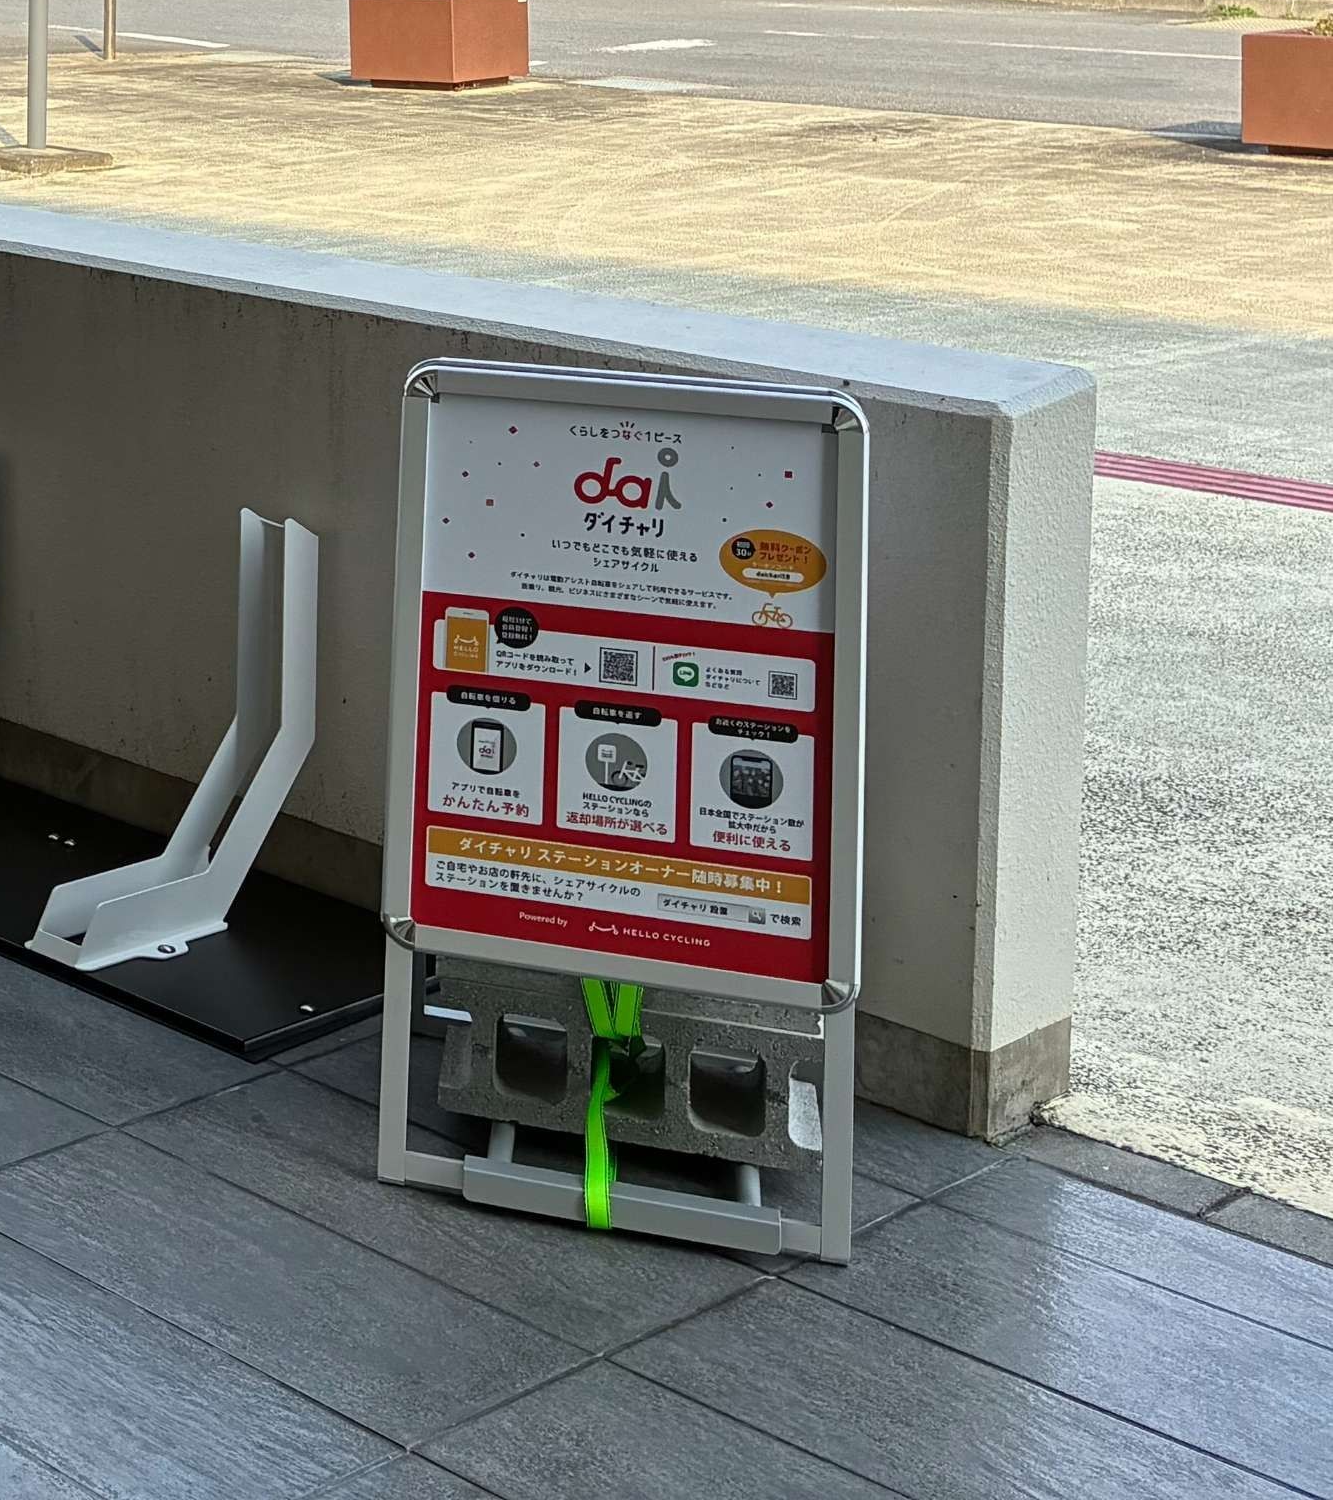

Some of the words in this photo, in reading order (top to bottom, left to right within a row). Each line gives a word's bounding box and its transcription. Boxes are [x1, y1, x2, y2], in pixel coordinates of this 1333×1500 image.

[569, 425, 682, 444] くらしをつなぐ1ピース
[573, 447, 682, 510] dai
[584, 512, 664, 538] ダイチャリ
[552, 539, 698, 562] いつでもどこでも気軽に使える
[759, 551, 808, 564] プレゼント！
[593, 557, 660, 573] シェアサイクル
[496, 650, 575, 666] QRコードを読み取って
[496, 660, 578, 676] アプリをダウンロード！
[592, 706, 643, 719] 自転車を返す
[715, 718, 791, 733] お近くのステーションを
[737, 728, 771, 739] チェック！
[452, 781, 521, 799] アプリで自転車を
[442, 794, 530, 818] かんたん予約
[582, 792, 609, 803] HELLO
[610, 795, 653, 809] CYCLINGの
[582, 801, 650, 818] ステーションなら
[565, 810, 668, 836] 返却場所が選べる
[699, 807, 805, 829] 日本全国でステーション数が
[713, 830, 791, 852] 便利に使える
[459, 836, 532, 859] ダイチャリ
[537, 848, 782, 894] ステーションオーナー随時募集中！
[435, 871, 584, 901] ステーションを置きませんか？
[436, 860, 641, 898] ご自宅やお店の軒先に、シェアサイクルの
[519, 911, 555, 925] Powered
[556, 916, 568, 928] by
[662, 898, 708, 912] ダイチャリ
[770, 913, 802, 926] で検索
[622, 928, 660, 940] HELLO
[662, 933, 711, 947] CYCLING
